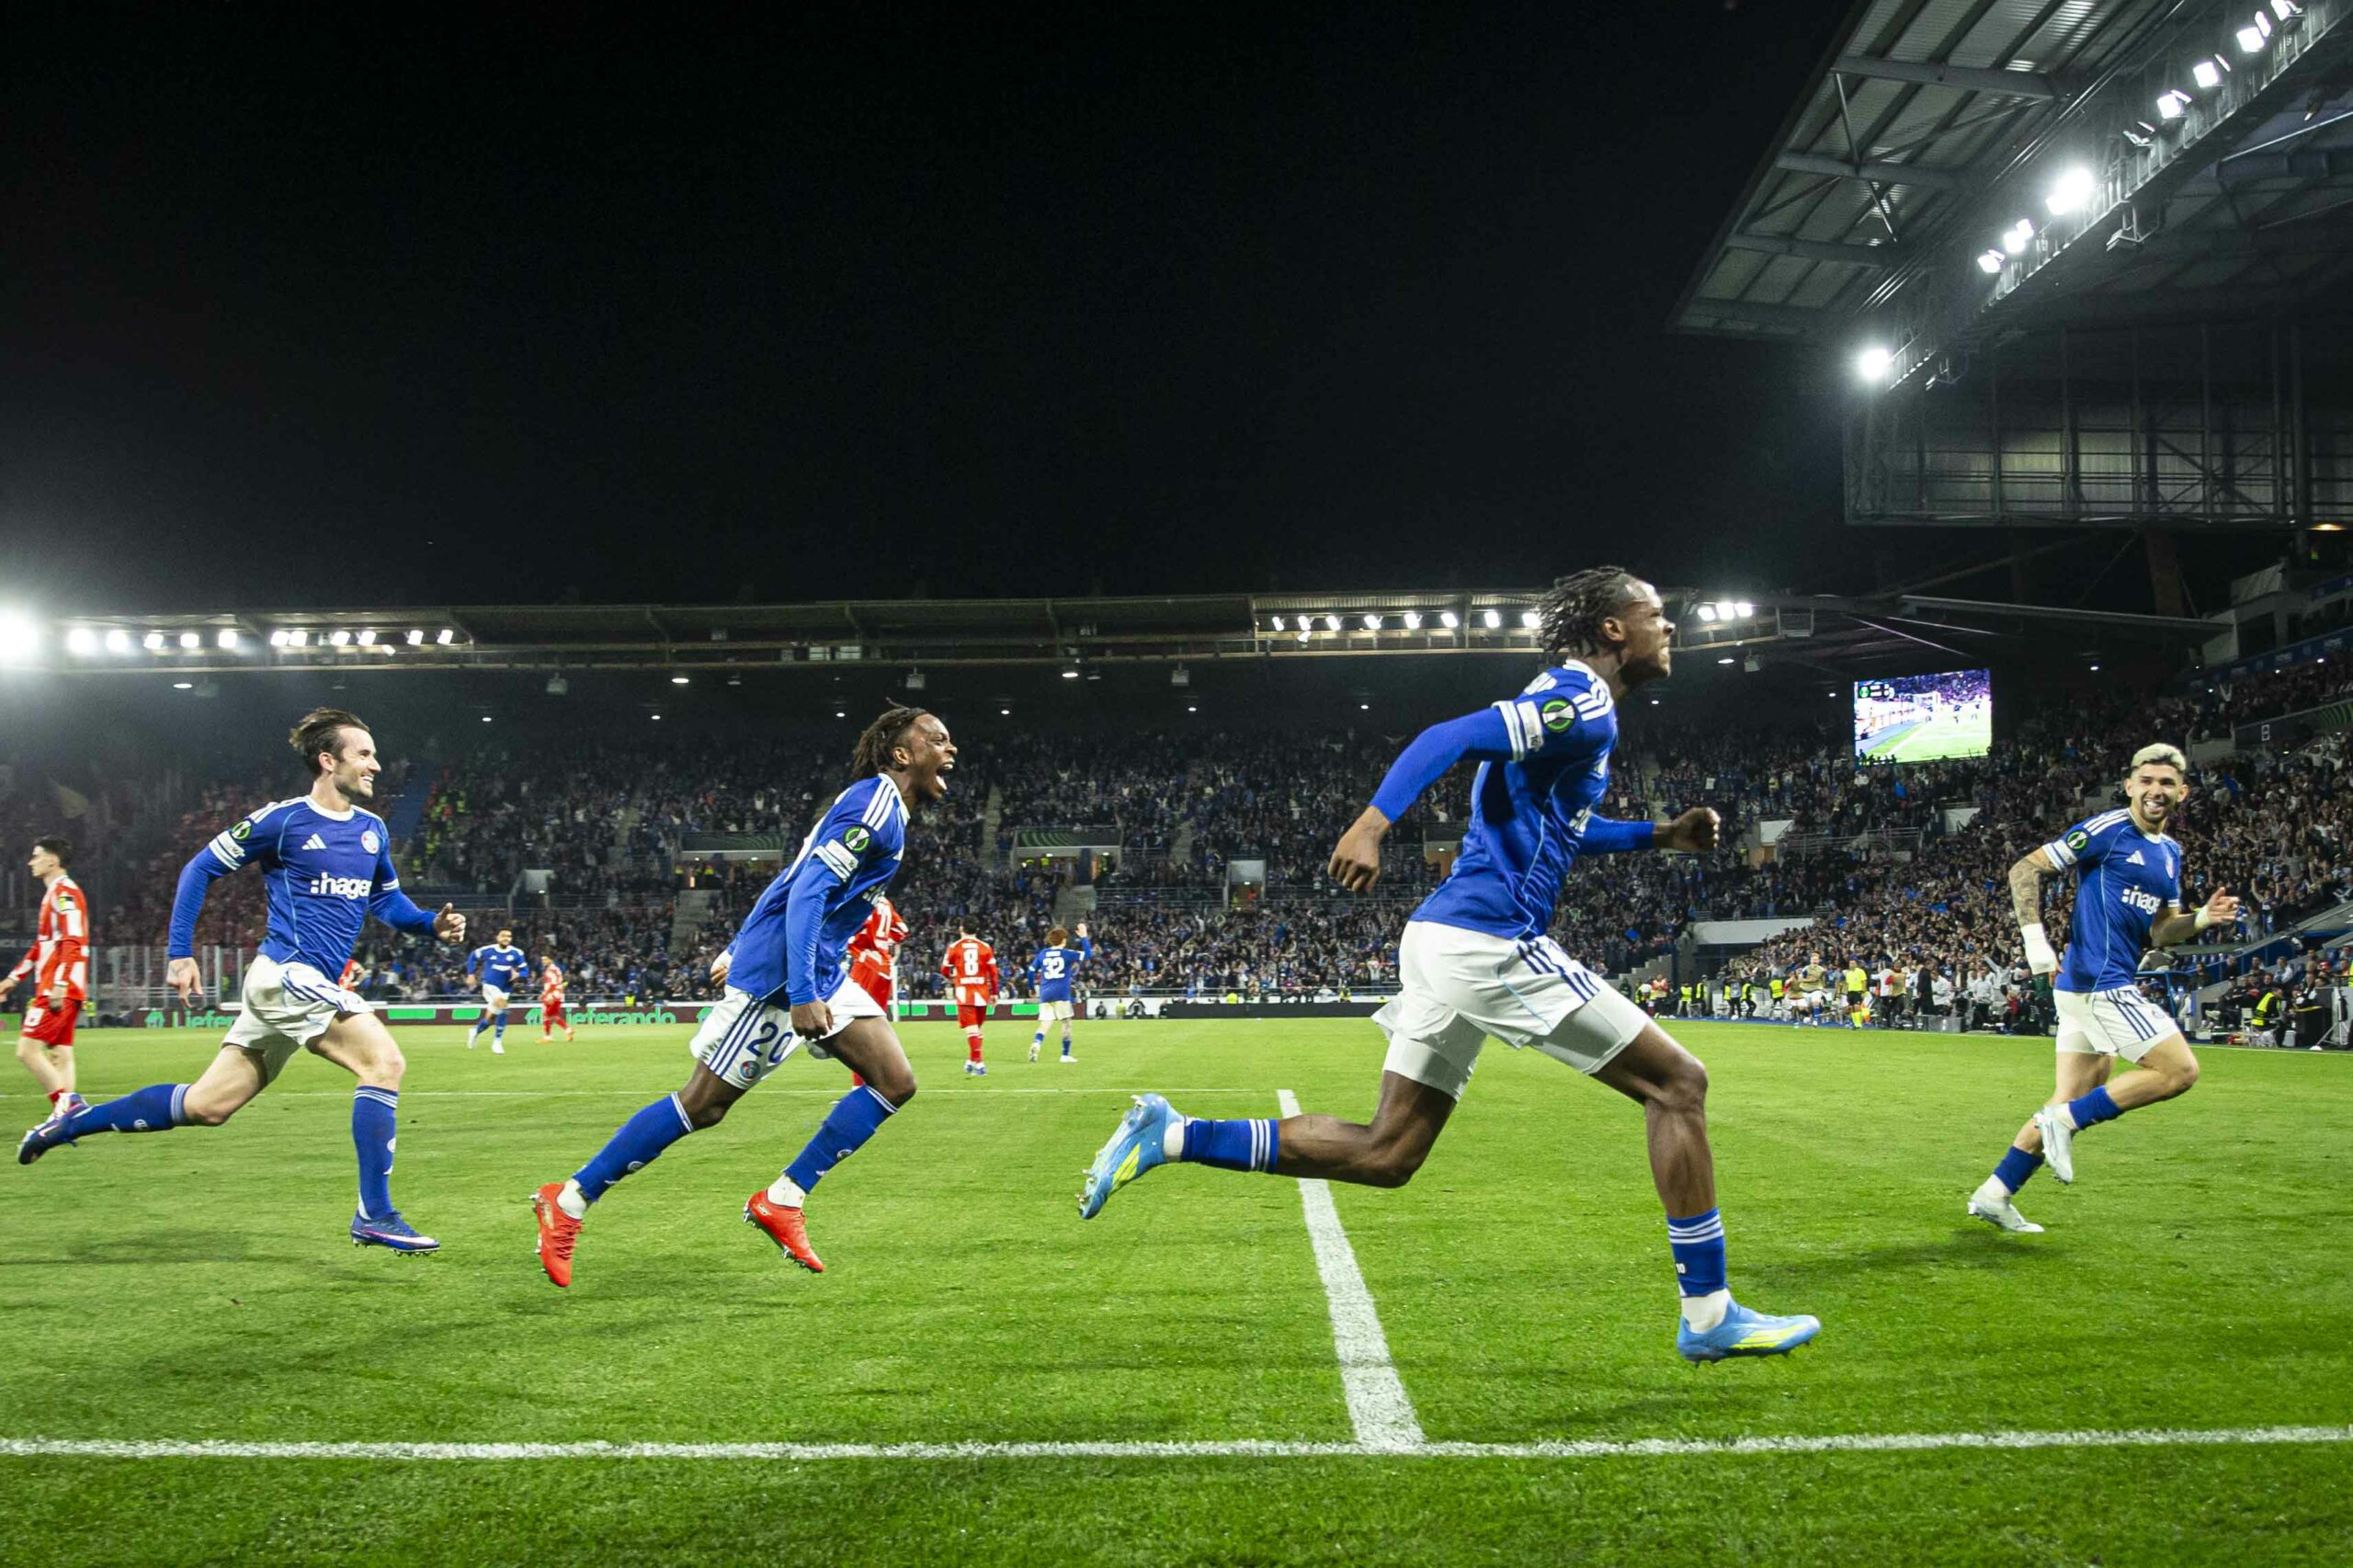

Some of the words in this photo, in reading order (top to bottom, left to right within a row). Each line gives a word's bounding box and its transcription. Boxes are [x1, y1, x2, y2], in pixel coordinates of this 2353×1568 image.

[963, 949, 979, 976] 8
[1042, 956, 1065, 979] 32
[172, 1009, 236, 1028] Liefer
[565, 1006, 676, 1026] ieferando
[746, 1021, 793, 1063] 20
